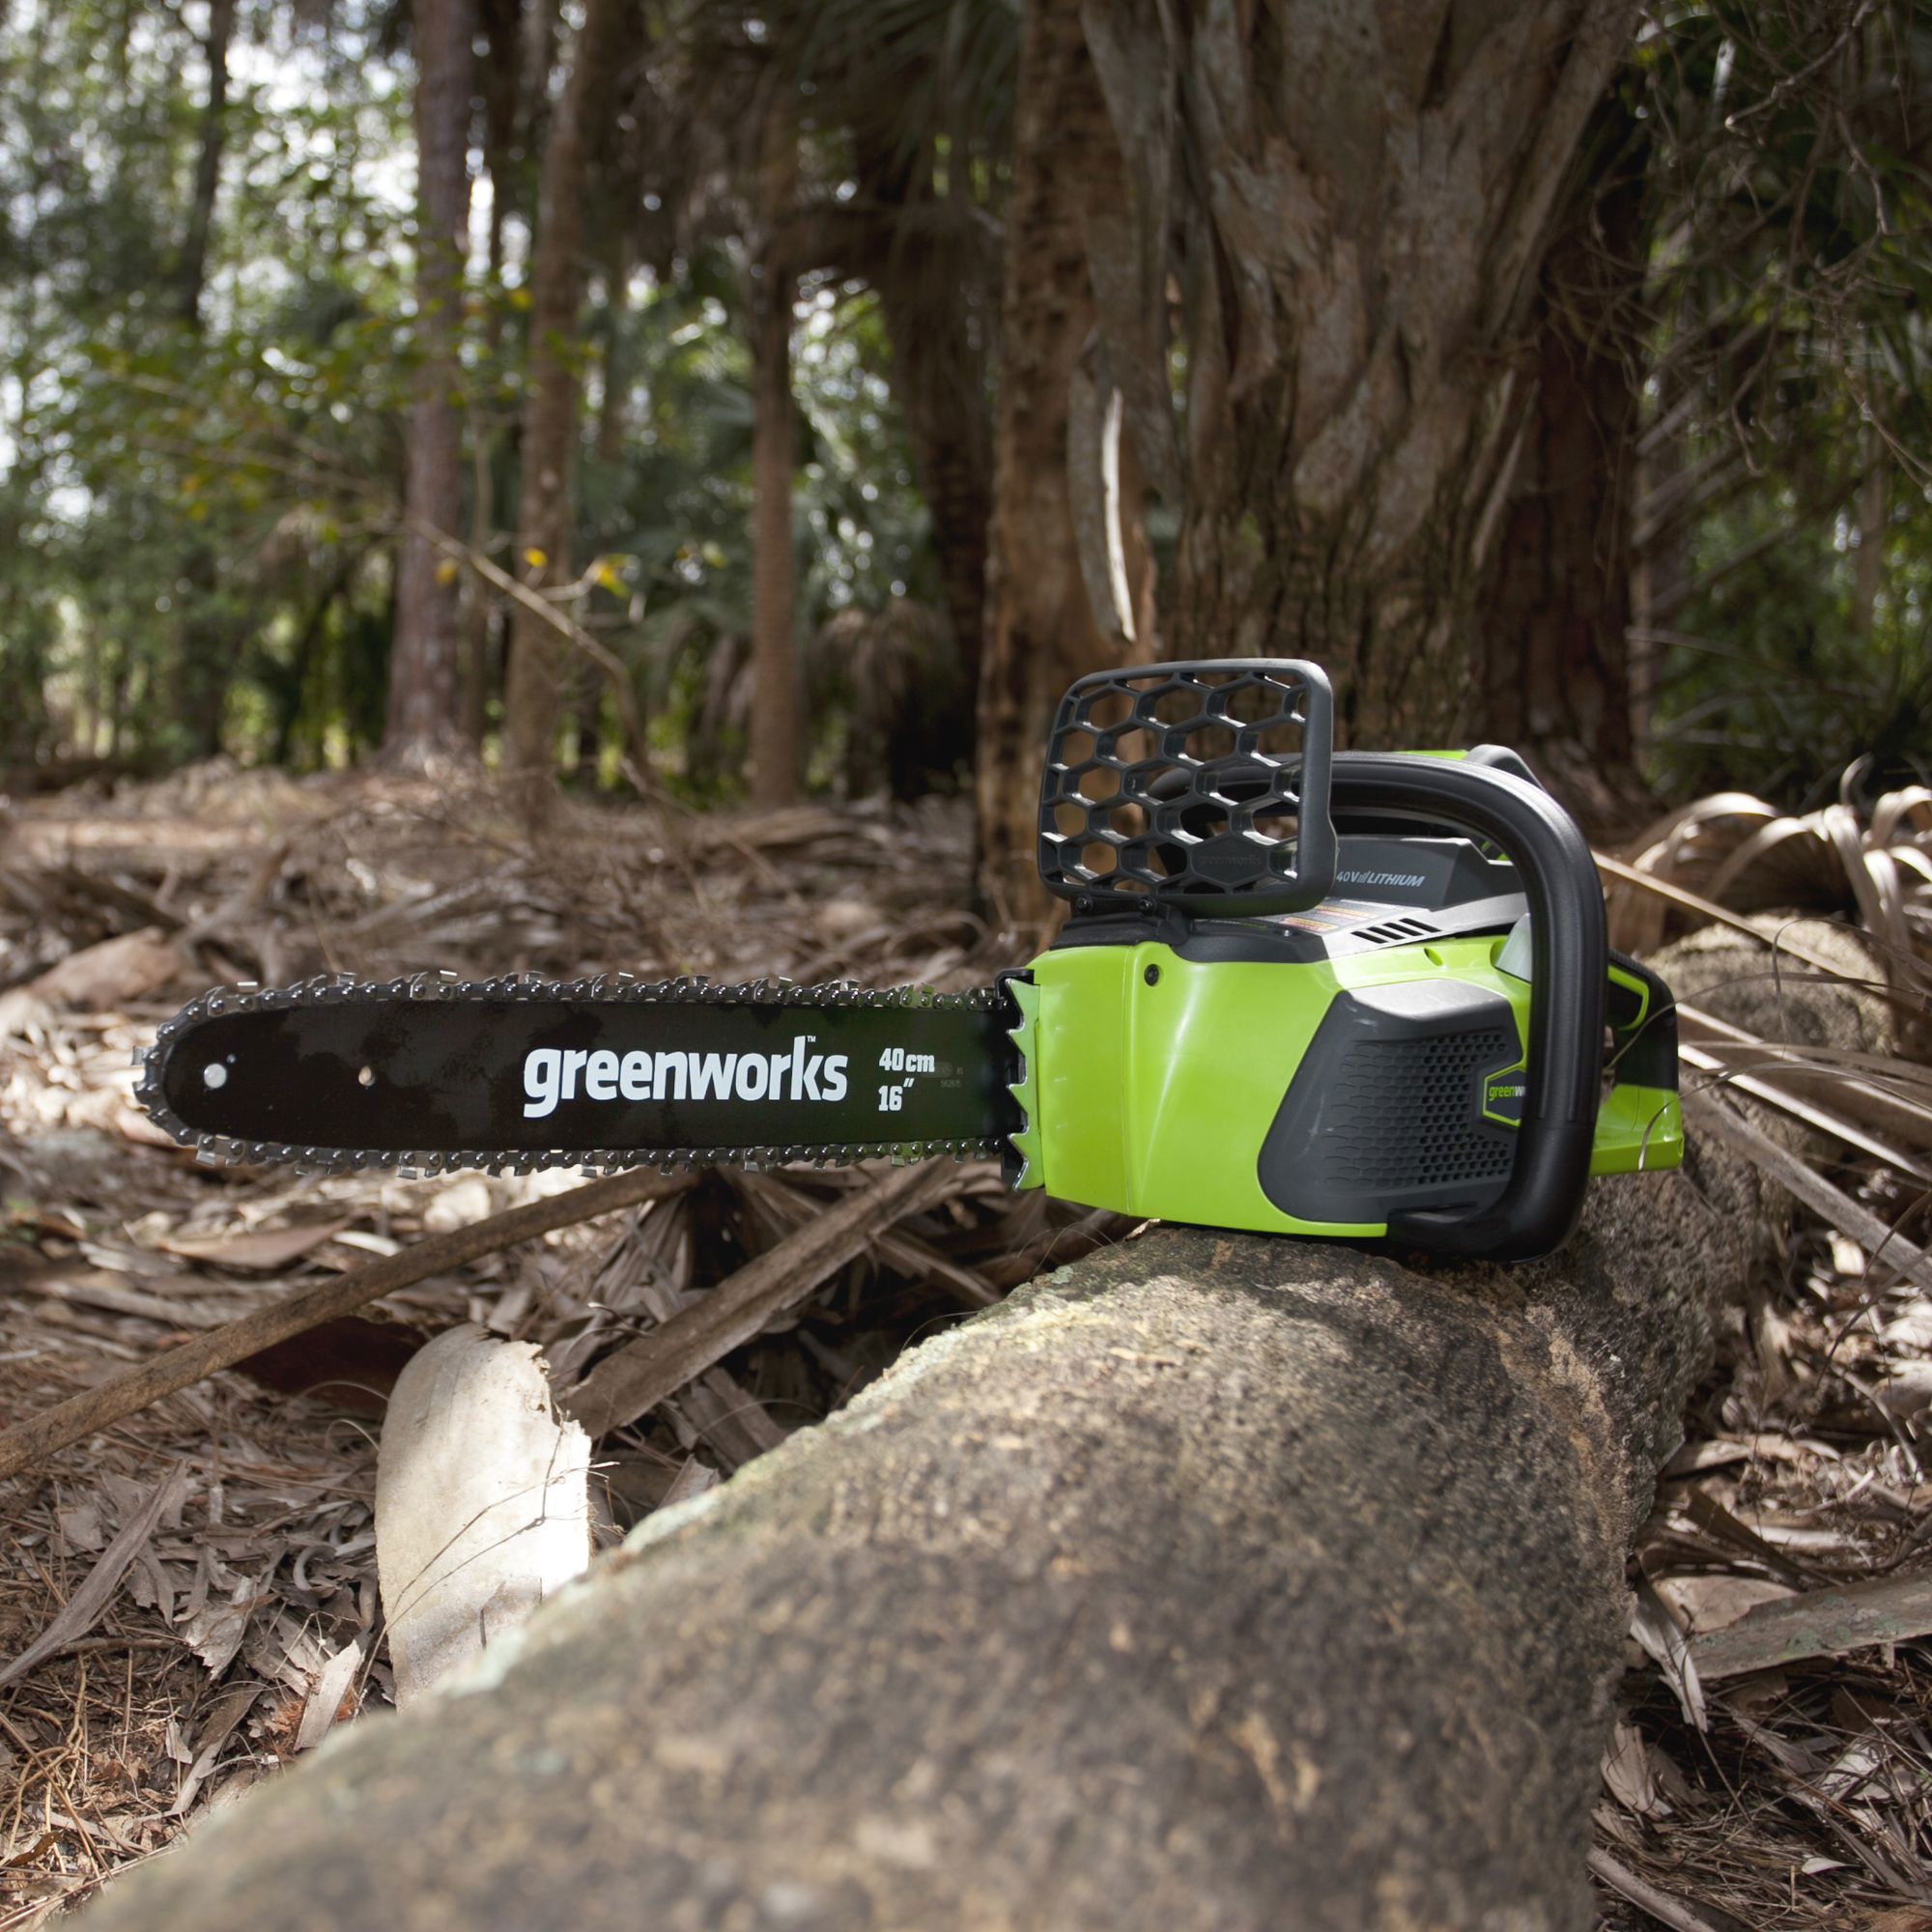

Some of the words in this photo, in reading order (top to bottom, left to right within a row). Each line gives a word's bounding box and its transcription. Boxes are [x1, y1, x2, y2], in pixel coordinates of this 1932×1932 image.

[1336, 871, 1360, 883] 40V
[1366, 872, 1426, 888] LITHIUM
[523, 1036, 849, 1119] greenworks
[1489, 1085, 1525, 1101] greenw
